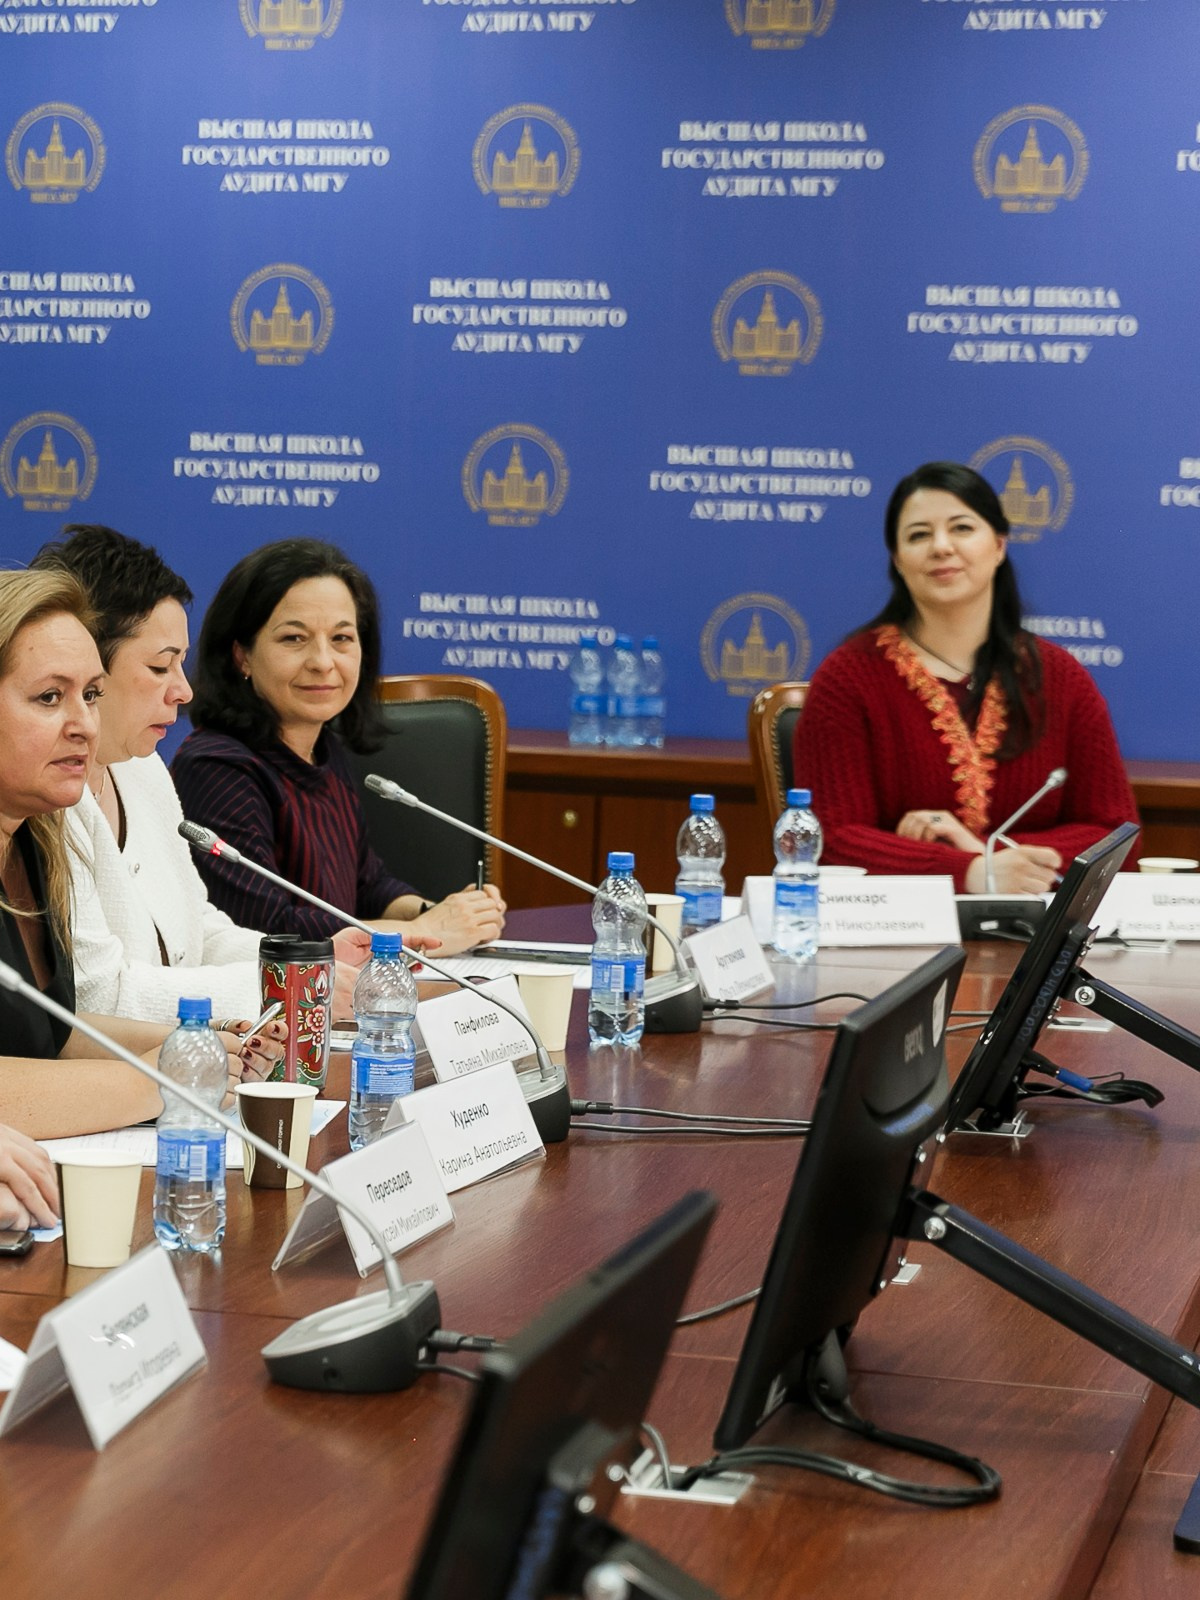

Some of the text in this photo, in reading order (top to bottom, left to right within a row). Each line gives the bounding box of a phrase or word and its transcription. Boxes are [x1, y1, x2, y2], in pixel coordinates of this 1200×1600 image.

[74, 13, 119, 33] МГУ
[461, 12, 594, 34] АУДИТА МГУ
[964, 8, 1108, 31] АУДИТА МГУ
[198, 119, 374, 140] ВЫСШАЯ ШКОЛА
[678, 121, 868, 143] ВЫСШАЯ ШКОЛА
[181, 145, 391, 168] ГОСУДАРСТВЕННОГО
[661, 148, 885, 171] ГОСУДАРСТВЕННОГО
[220, 172, 349, 194] АУДИТА МГУ
[702, 176, 839, 198] АУДИТА МГУ
[60, 272, 136, 293] ШКОЛА
[429, 277, 611, 301] ВЫСШАЯ ШКОЛА
[925, 286, 1121, 309] ВЫСШАЯ ШКОЛА
[412, 304, 628, 328] ГОСУДАРСТВЕННОГО
[907, 313, 1139, 337] ГОСУДАРСТВЕННОГО
[66, 324, 112, 344] МГУ
[451, 332, 584, 354] АУДИТА МГУ
[950, 342, 1089, 364] АУДИТА МГУ
[189, 432, 365, 456] ВЫСШАЯ ШКОЛА
[666, 445, 854, 470] ВЫСШАЯ ШКОЛА
[173, 458, 381, 483] ГОСУДАРСТВЕННОГО
[649, 471, 872, 497] ГОСУДАРСТВЕННОГО
[211, 485, 339, 508] АУДИТА МГУ
[690, 500, 825, 523] АУДИТА МГУ
[419, 593, 599, 619] ВЫСШАЯ ШКОЛА
[442, 646, 523, 669] АУДИТА
[454, 1012, 500, 1037] Панфилова
[449, 1040, 529, 1075] Татьяна Михайловна
[449, 1103, 490, 1129] Худенко
[438, 1131, 528, 1177] Карина Анатольевна
[366, 1170, 413, 1204] Переседов
[396, 1203, 441, 1235] Михайлович
